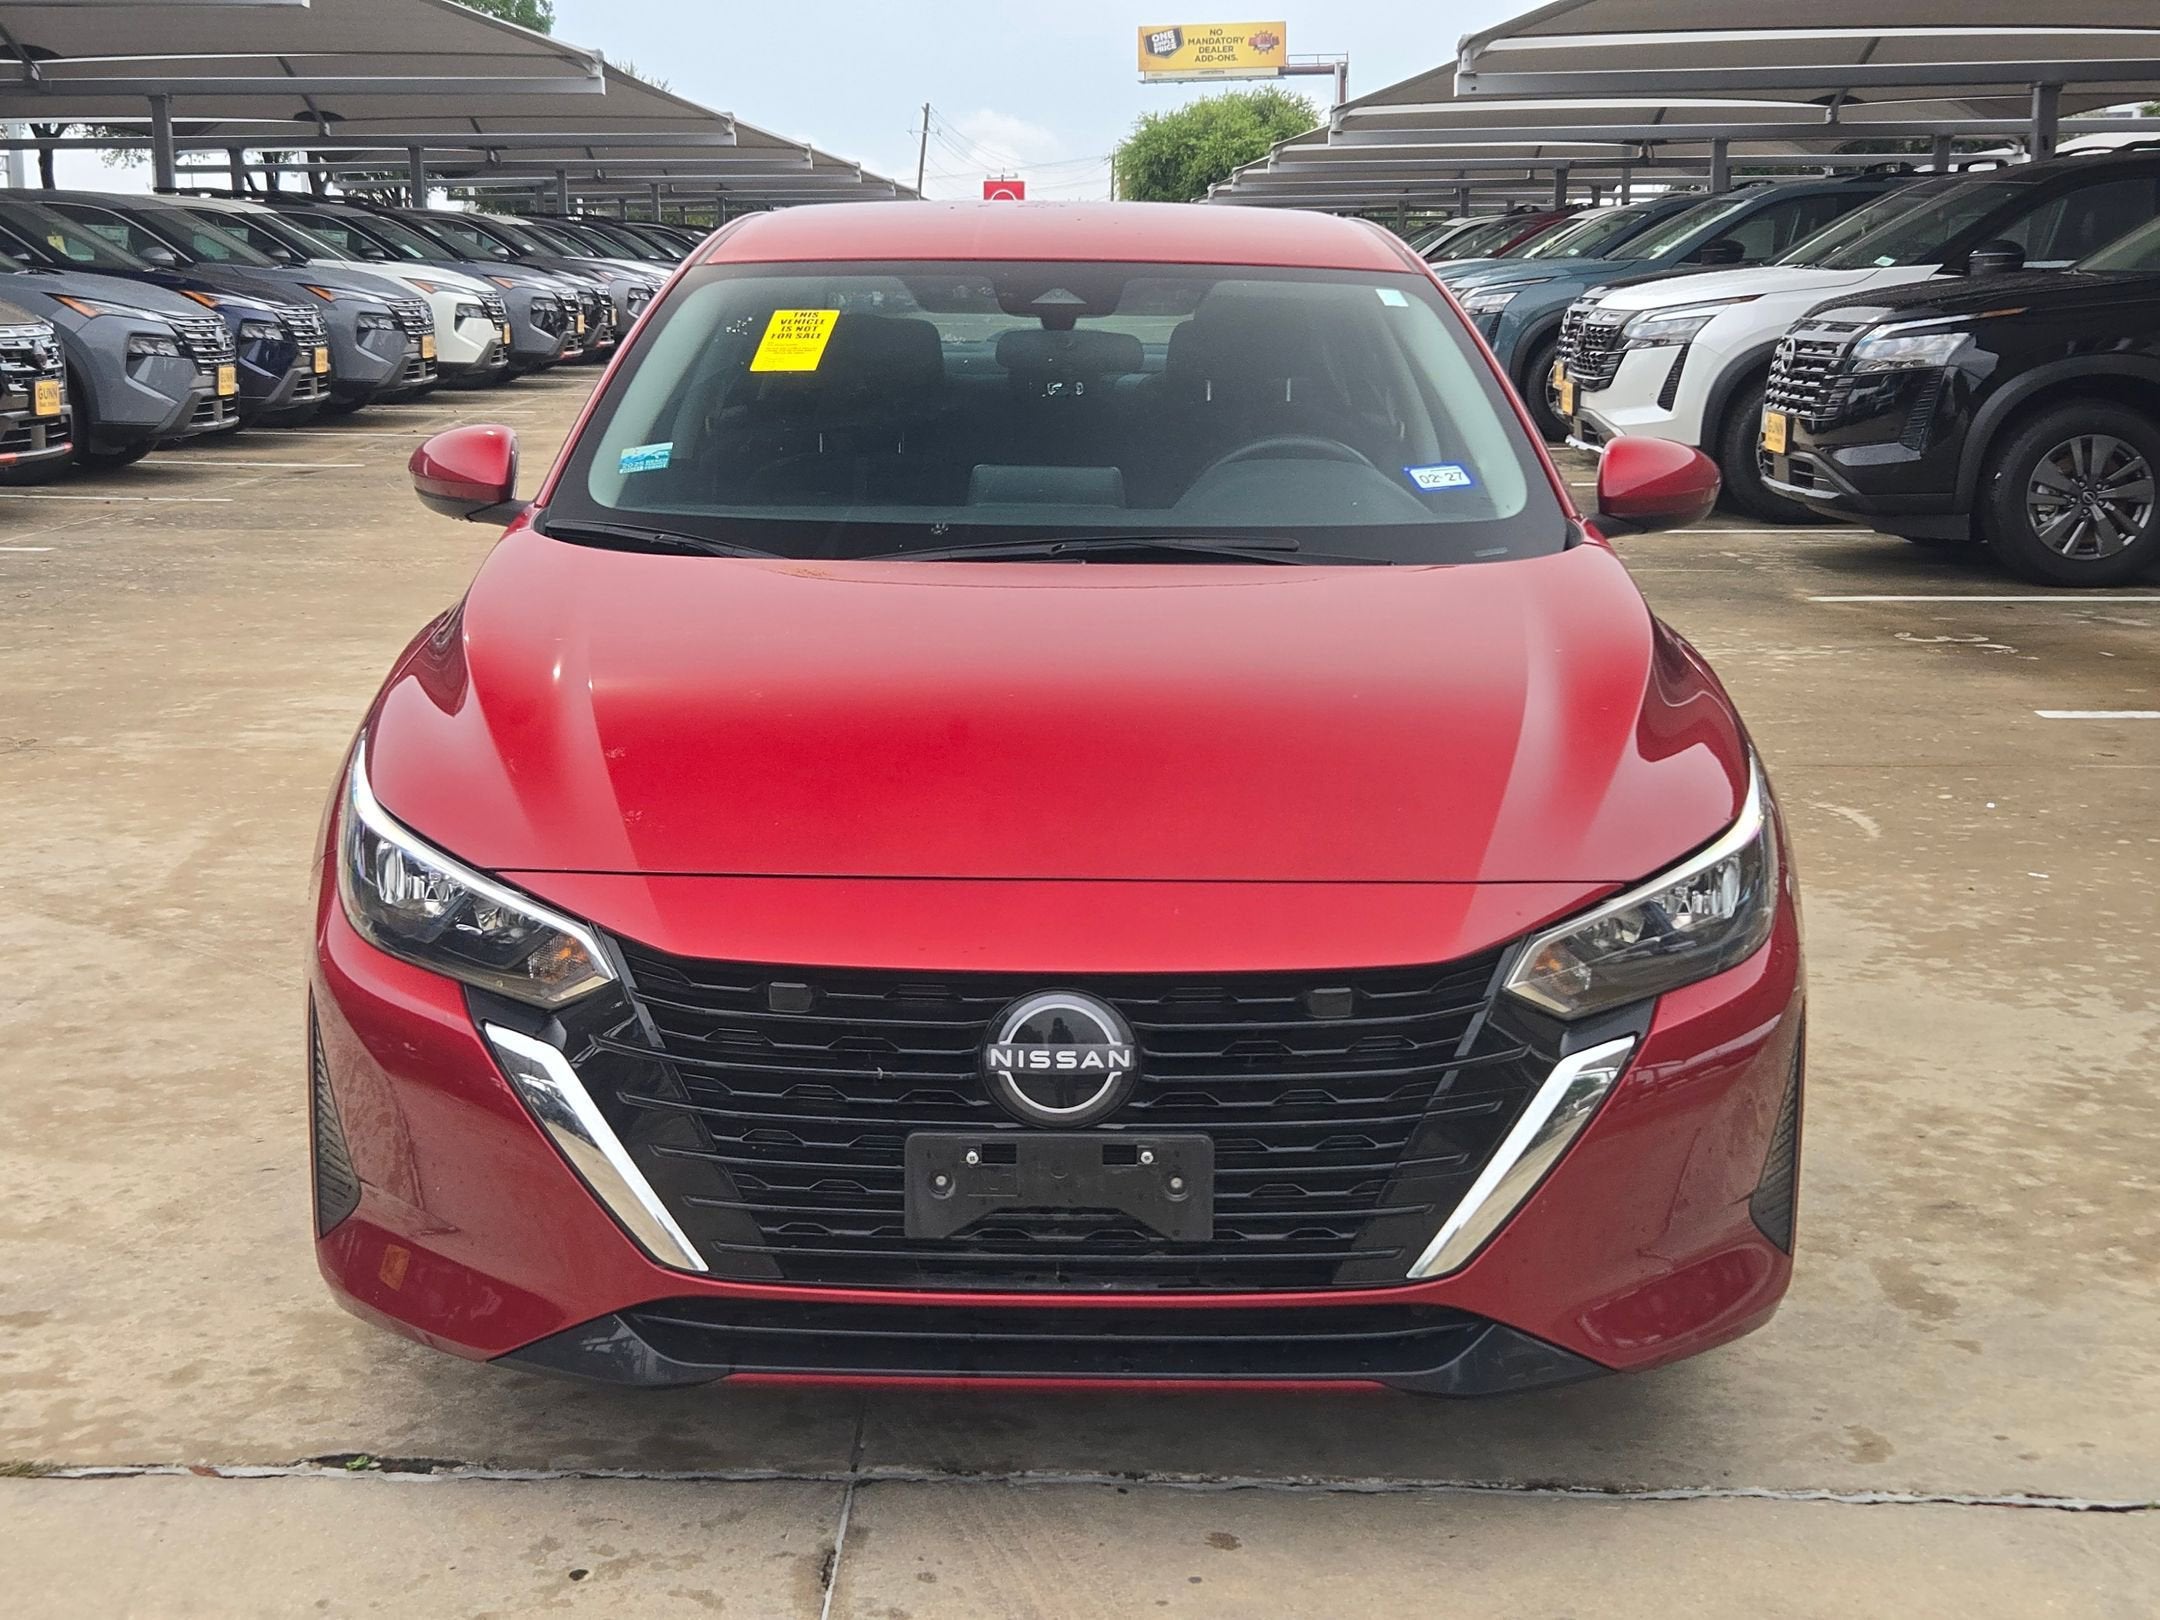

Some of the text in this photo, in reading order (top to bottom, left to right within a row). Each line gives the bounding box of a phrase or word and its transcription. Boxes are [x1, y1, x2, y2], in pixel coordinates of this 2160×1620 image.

[1151, 30, 1175, 42] ONE
[1209, 28, 1223, 36] NO
[1187, 36, 1245, 46] MANDATORY
[1198, 45, 1234, 54] DEALER
[1194, 54, 1239, 63] ADD-ONS.
[793, 311, 819, 319] THIS
[770, 332, 822, 340] FOR SALE
[38, 386, 58, 400] GUNN
[990, 1048, 1131, 1069] NISSAN
